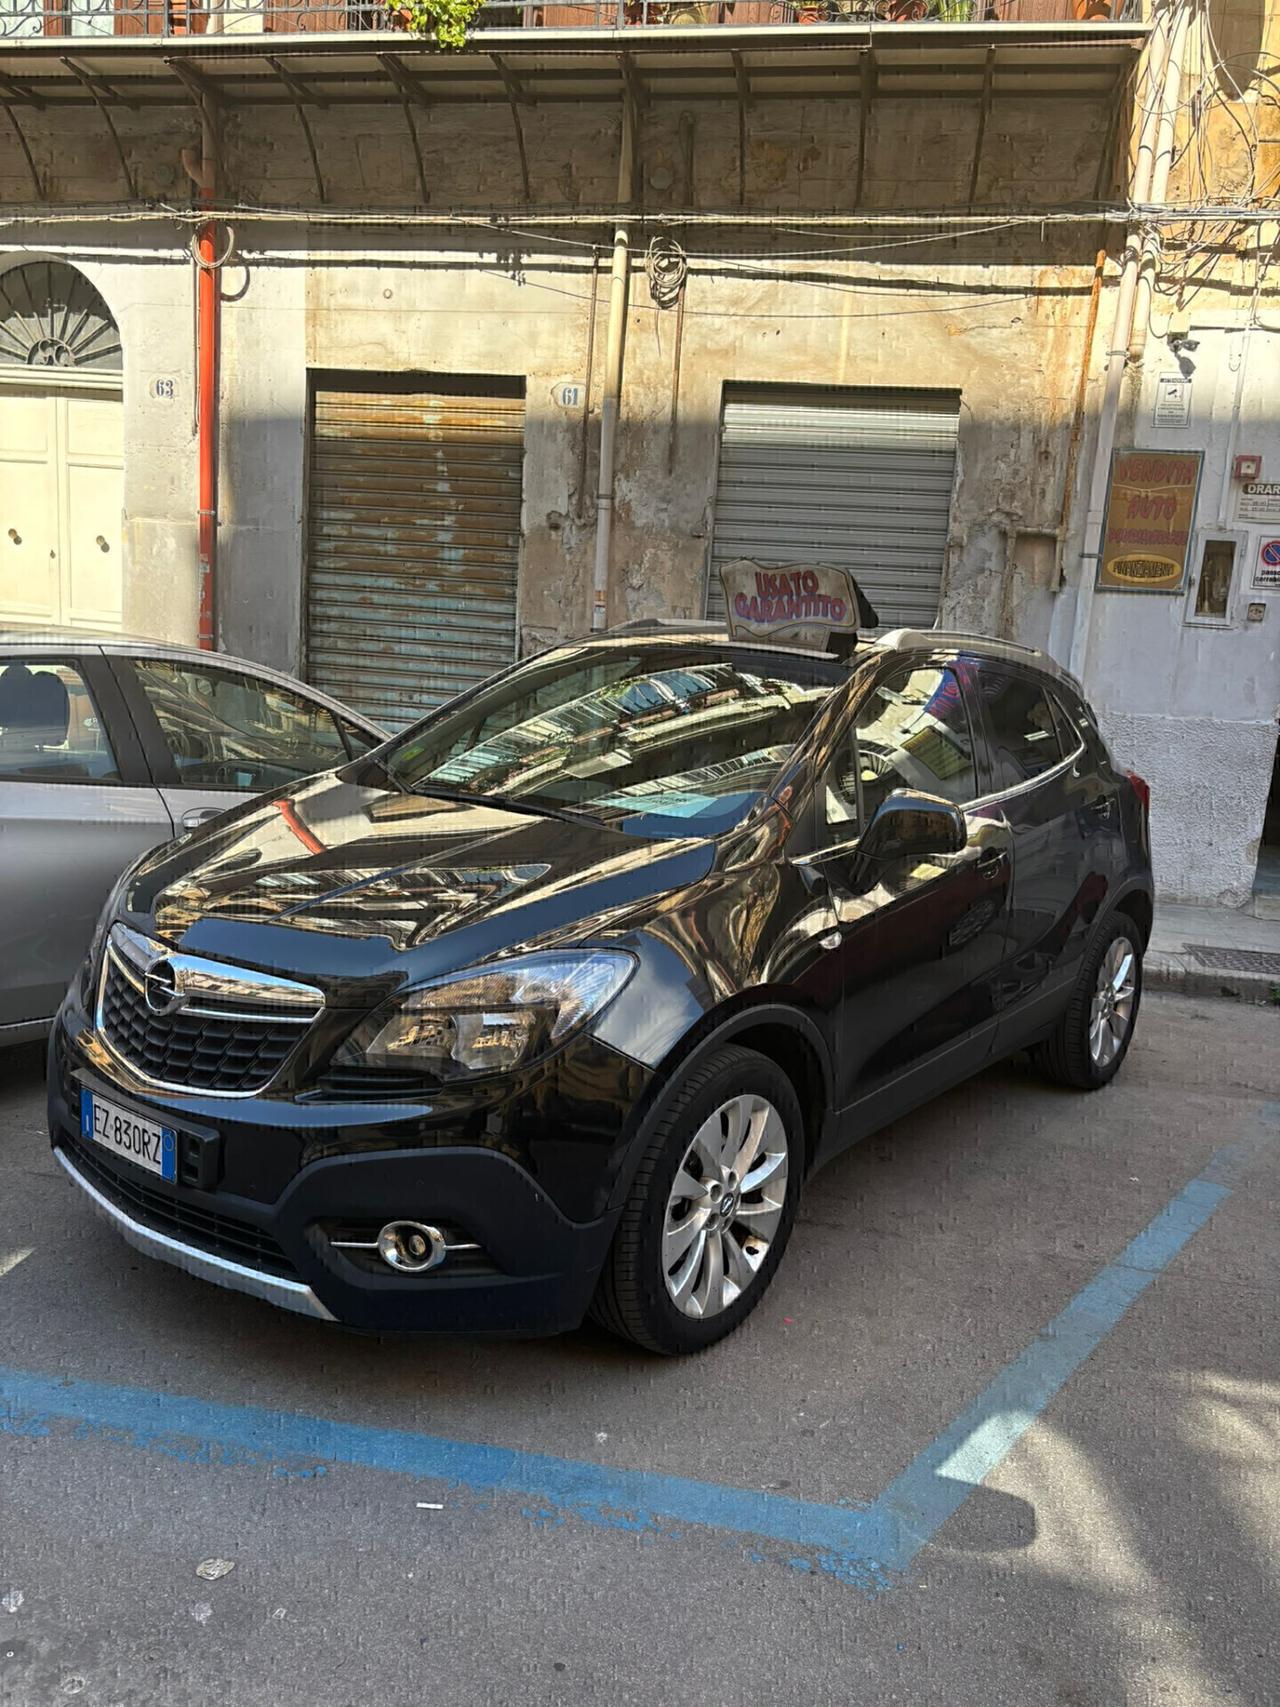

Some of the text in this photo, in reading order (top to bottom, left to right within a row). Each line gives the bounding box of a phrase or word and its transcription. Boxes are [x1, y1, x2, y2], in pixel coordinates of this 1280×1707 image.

[156, 379, 174, 399] 63
[562, 387, 578, 405] 61
[1118, 458, 1196, 484] VENDITA
[1127, 495, 1177, 520] AUTO
[755, 570, 819, 599] USATO
[734, 592, 847, 623] GARANTITO
